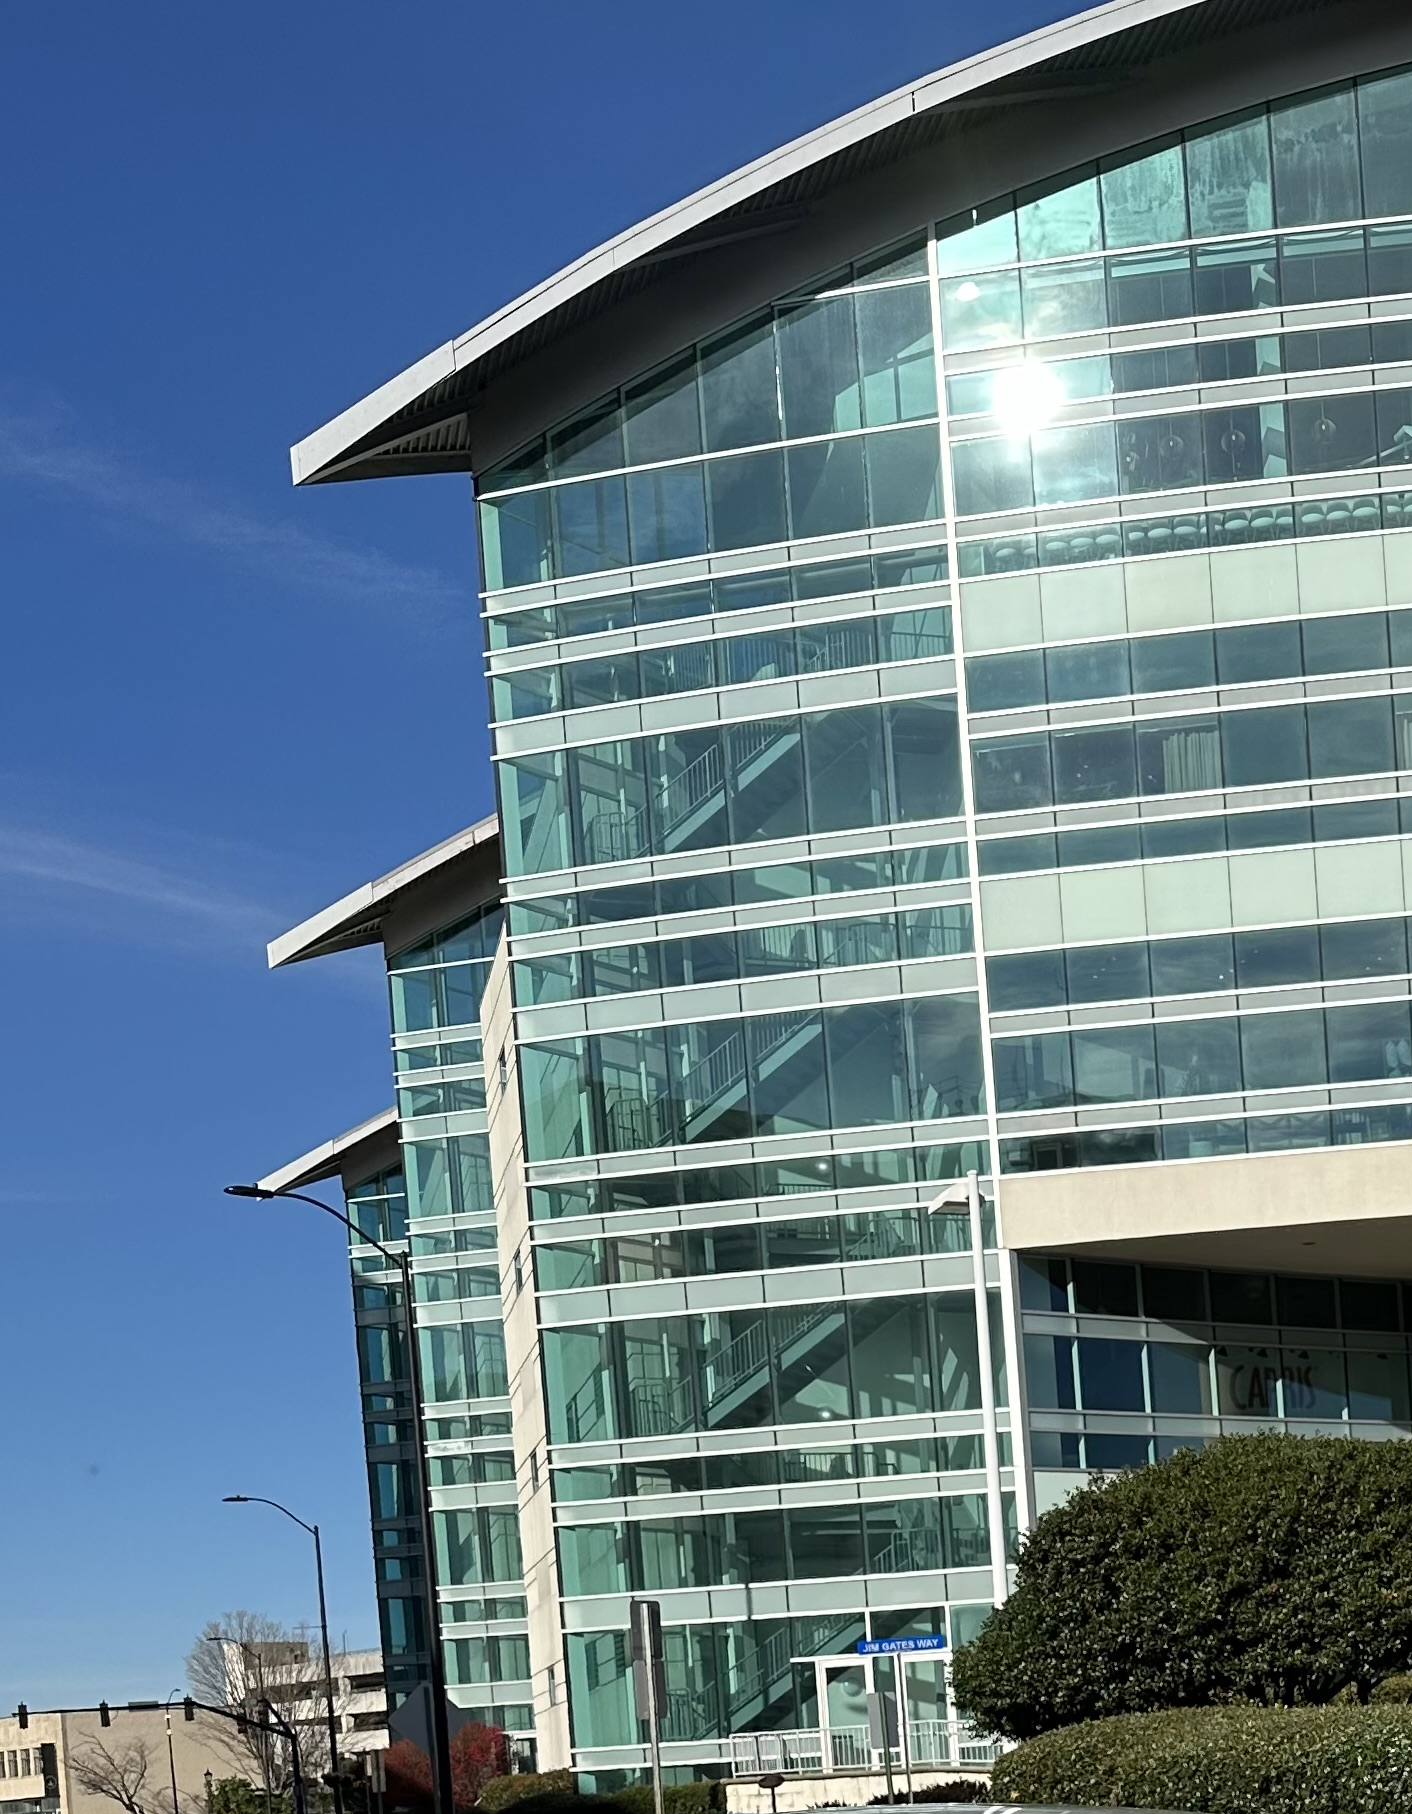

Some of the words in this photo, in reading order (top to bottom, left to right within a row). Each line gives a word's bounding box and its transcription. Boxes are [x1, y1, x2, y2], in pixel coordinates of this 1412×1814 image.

[863, 1643, 879, 1653] JIM
[882, 1640, 915, 1651] GATES
[917, 1638, 939, 1648] WAY
